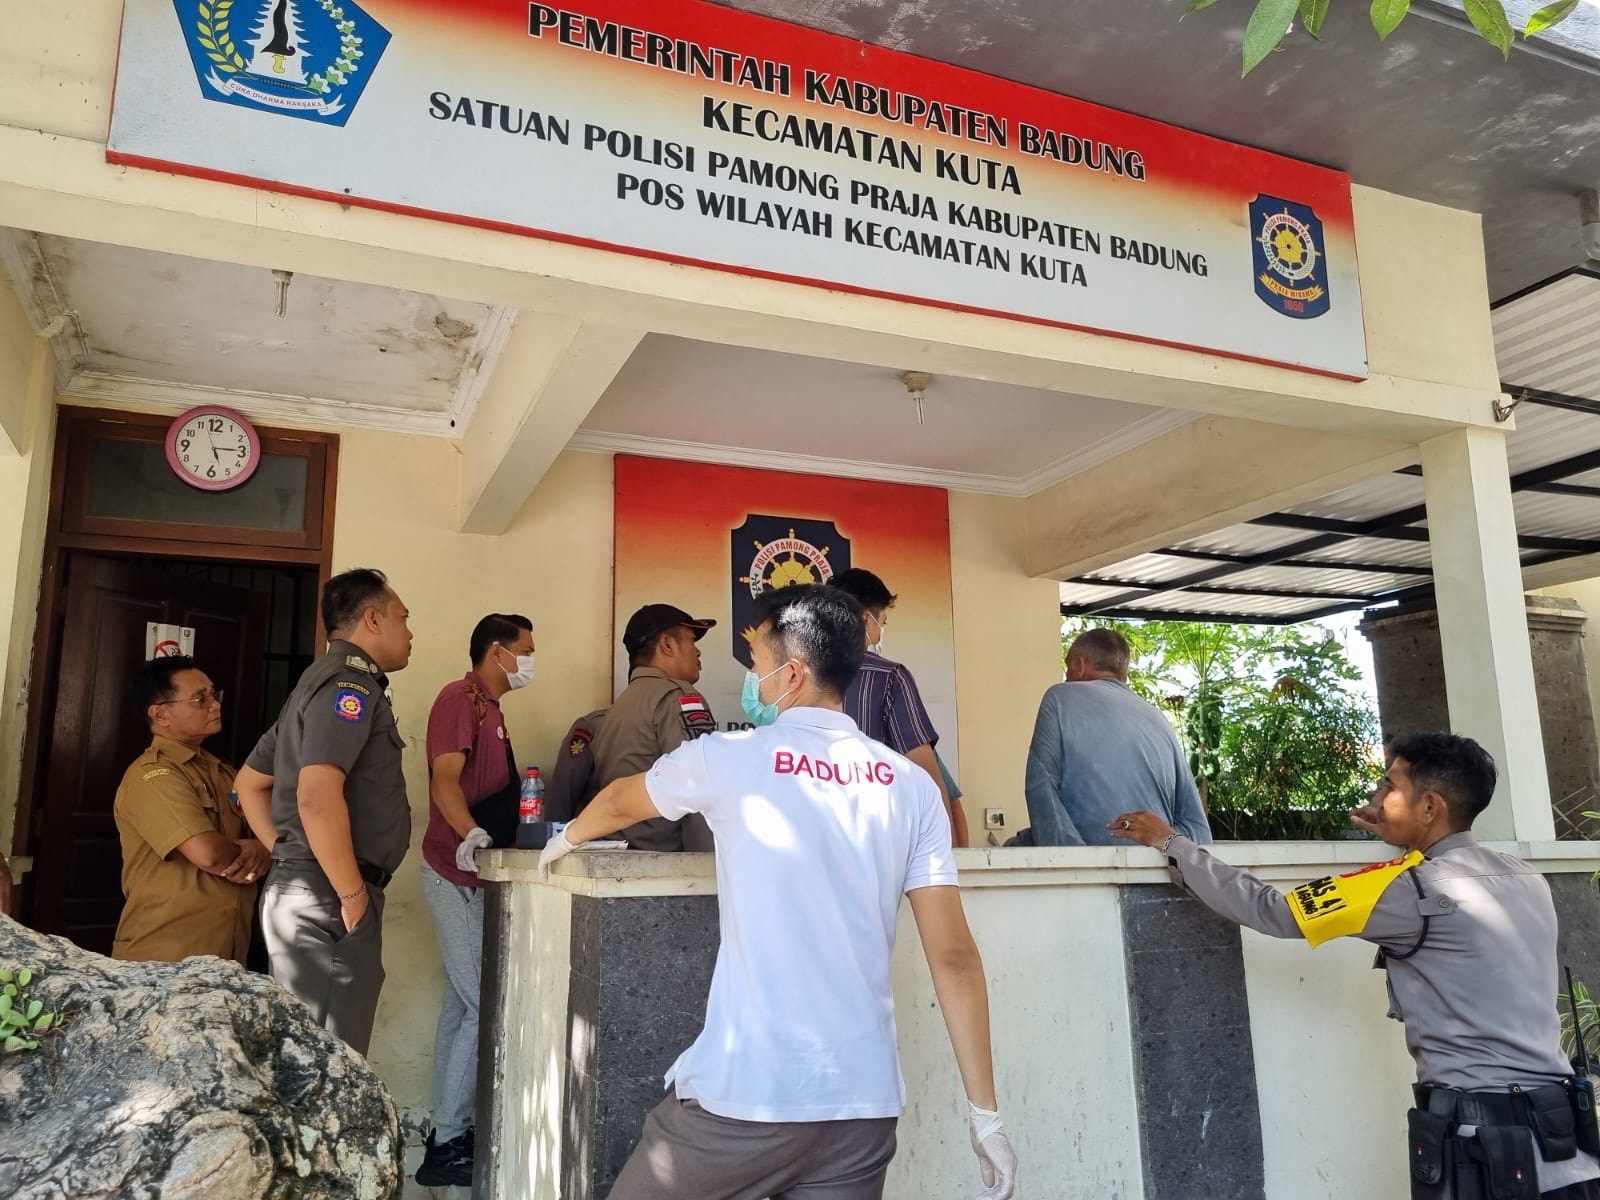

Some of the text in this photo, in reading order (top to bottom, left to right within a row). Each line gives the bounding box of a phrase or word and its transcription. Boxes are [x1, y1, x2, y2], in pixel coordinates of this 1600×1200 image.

[528, 1, 1146, 181] PEMERINTAH KABUPATEN BADUNG
[702, 96, 1022, 195] KECAMATAN KUTA
[428, 91, 1208, 277] SATUAN POLISI PAMONG PRAJA KABUPATEN BADUNG
[616, 172, 1088, 288] POS WILAYAH KECAMATAN KUTA
[197, 421, 205, 429] 11
[208, 418, 224, 433] 12
[229, 424, 233, 433] 1
[186, 429, 196, 437] 10
[238, 434, 244, 442] 2
[180, 439, 191, 452] 9
[237, 445, 246, 458] 3
[183, 454, 190, 462] 8
[235, 460, 241, 468] 4
[206, 465, 216, 478] 6
[225, 468, 231, 476] 5
[754, 540, 830, 576] POLISI PAMONG PRAJA
[774, 751, 895, 786] BADUNG
